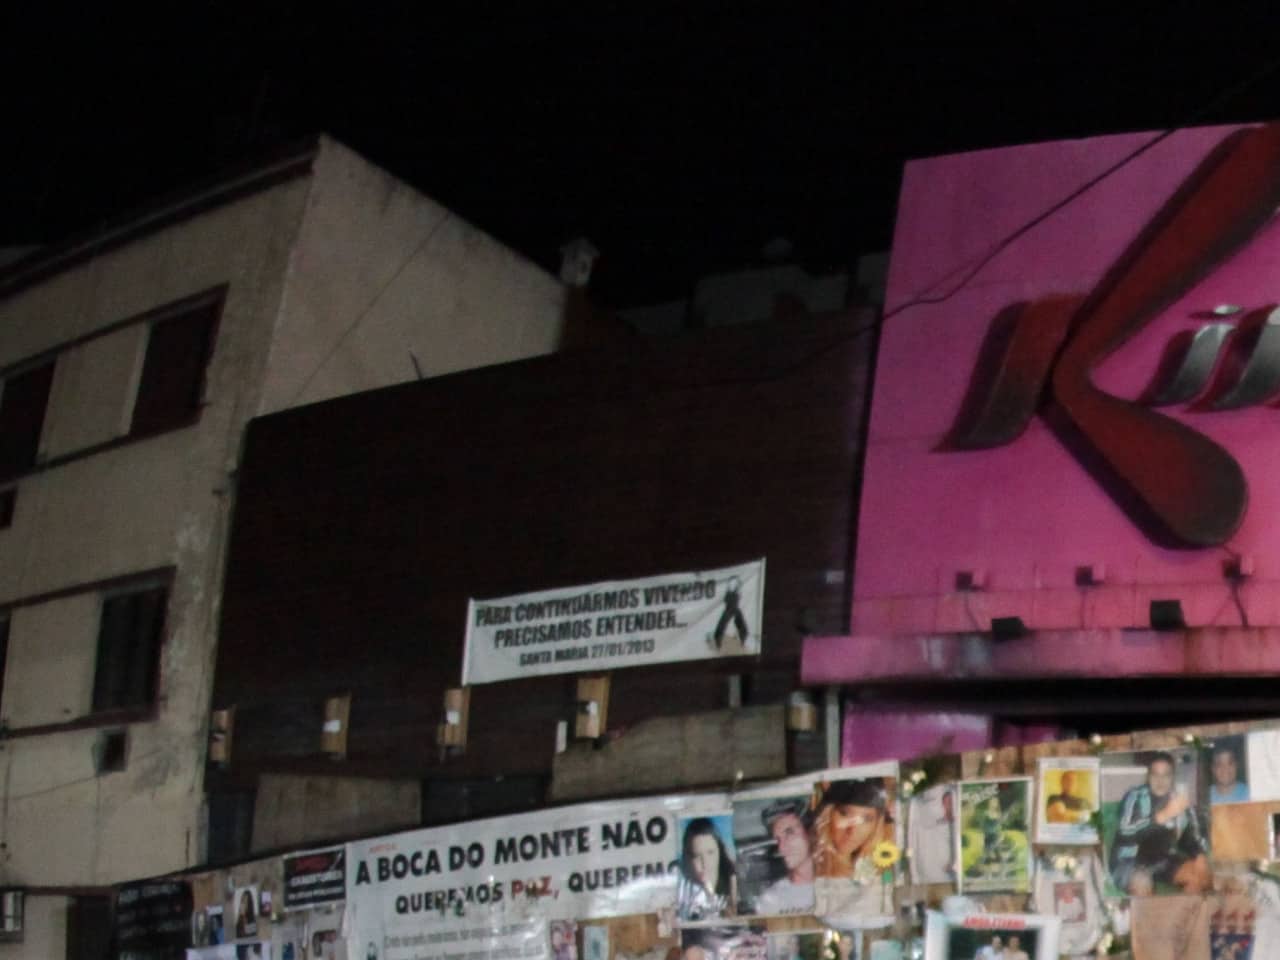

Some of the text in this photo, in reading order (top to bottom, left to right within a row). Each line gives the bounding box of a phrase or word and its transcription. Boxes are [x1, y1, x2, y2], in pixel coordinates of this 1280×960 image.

[475, 603, 513, 627] PARA
[514, 588, 640, 624] CONTINUARMOS
[494, 617, 593, 649] PRECISAMOS
[354, 859, 371, 886] A
[377, 848, 441, 883] BOCA
[449, 842, 485, 872] DO
[494, 826, 591, 866] MONTE
[601, 811, 669, 850] NÃO
[395, 881, 504, 915] QUEREMOS
[567, 858, 680, 893] QUEREMO
